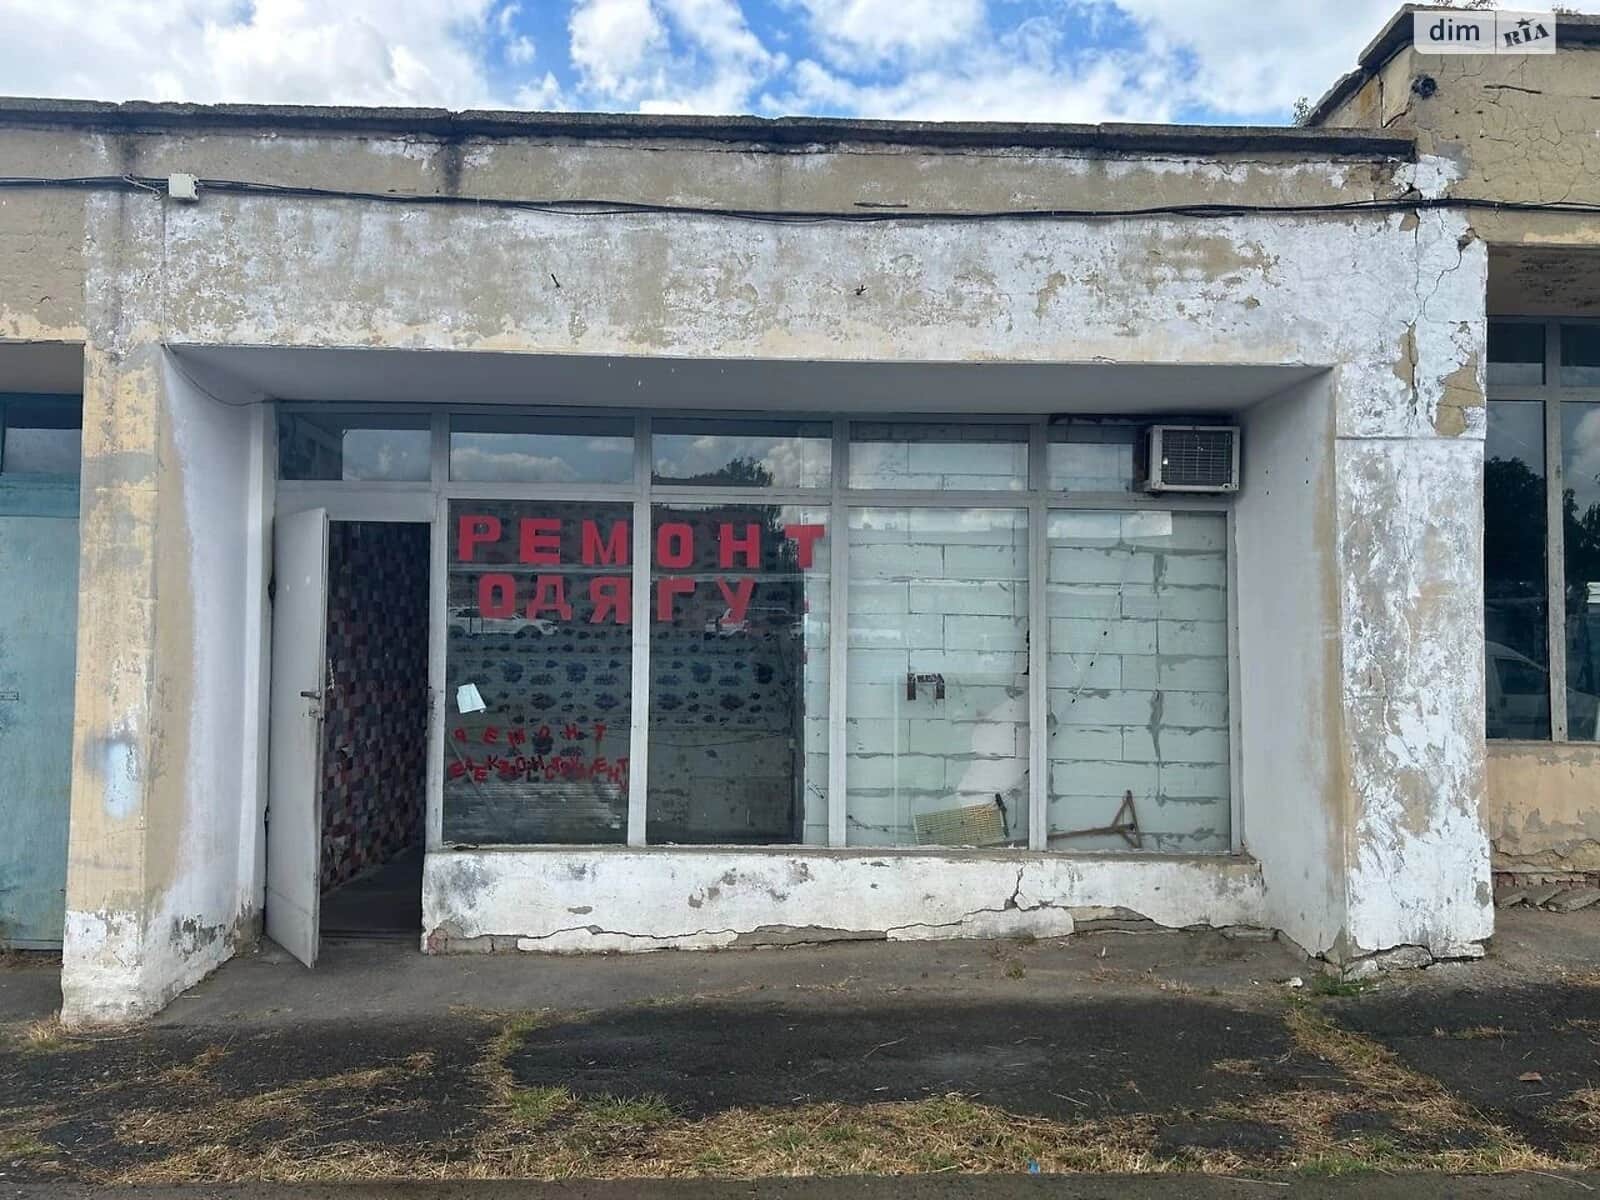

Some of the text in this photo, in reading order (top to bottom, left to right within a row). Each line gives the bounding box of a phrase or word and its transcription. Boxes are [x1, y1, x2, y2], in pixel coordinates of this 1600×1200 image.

[457, 514, 825, 569] РЕМОНТ
[478, 572, 757, 625] ОДЯГУ
[453, 723, 607, 747] РЕМОНТ
